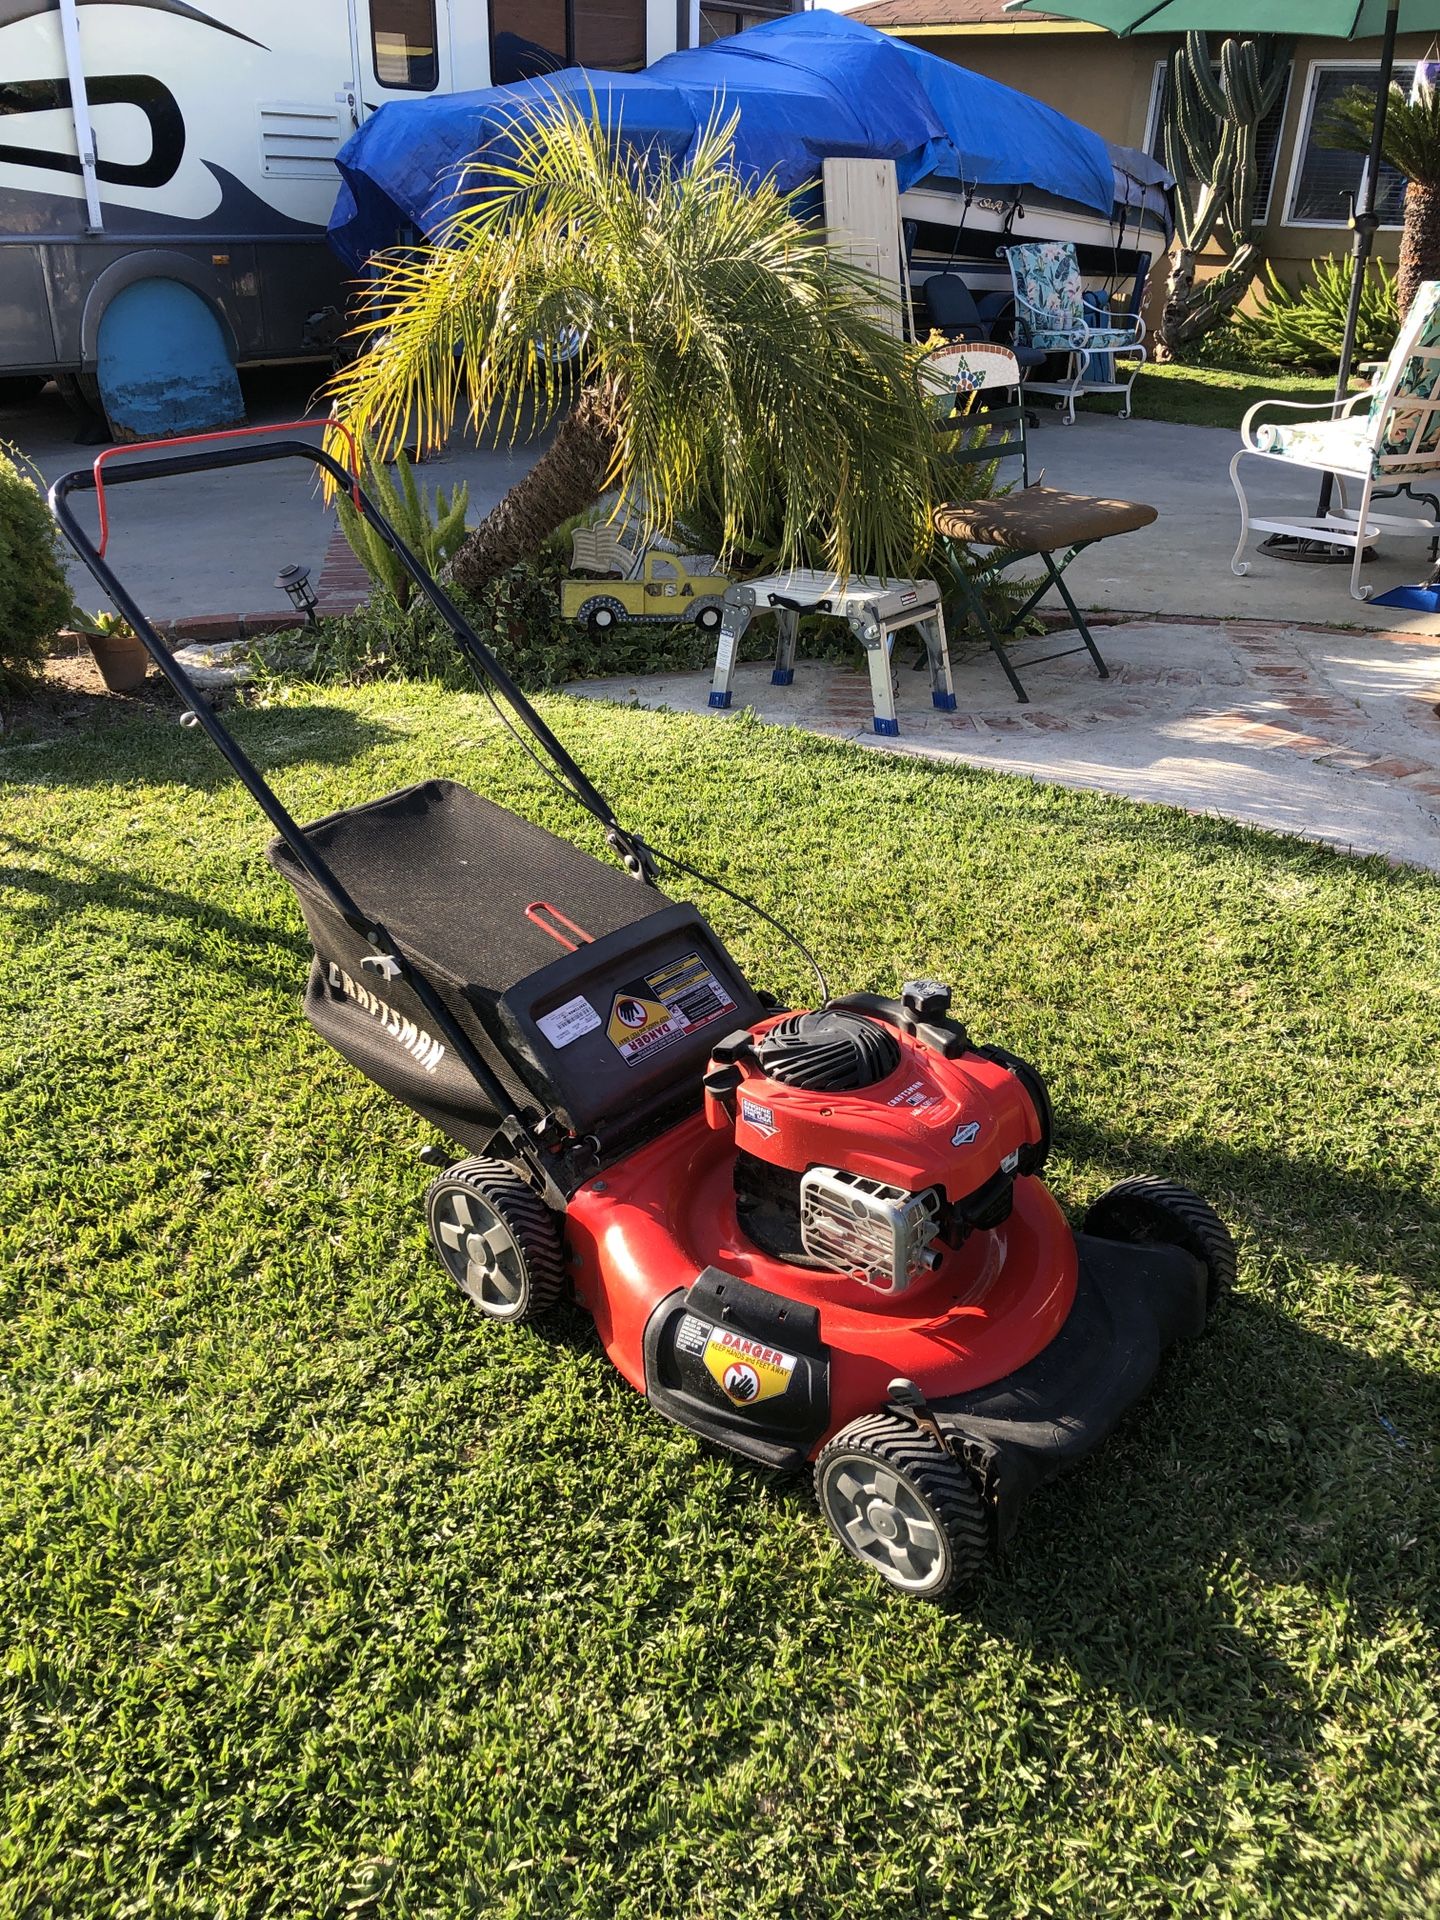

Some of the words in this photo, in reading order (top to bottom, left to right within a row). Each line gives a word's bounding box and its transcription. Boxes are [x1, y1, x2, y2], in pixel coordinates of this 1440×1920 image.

[644, 583, 694, 597] USA
[328, 961, 446, 1073] CRAFTSMAN
[628, 1023, 671, 1051] DANGER
[887, 1081, 924, 1107] CRAFTSMAN
[711, 1343, 726, 1352] KEEP
[726, 1346, 745, 1360] HANDS
[745, 1356, 756, 1365] and
[756, 1359, 770, 1371] FEET
[771, 1364, 789, 1377] AWAY
[722, 1332, 783, 1366] DANGER
